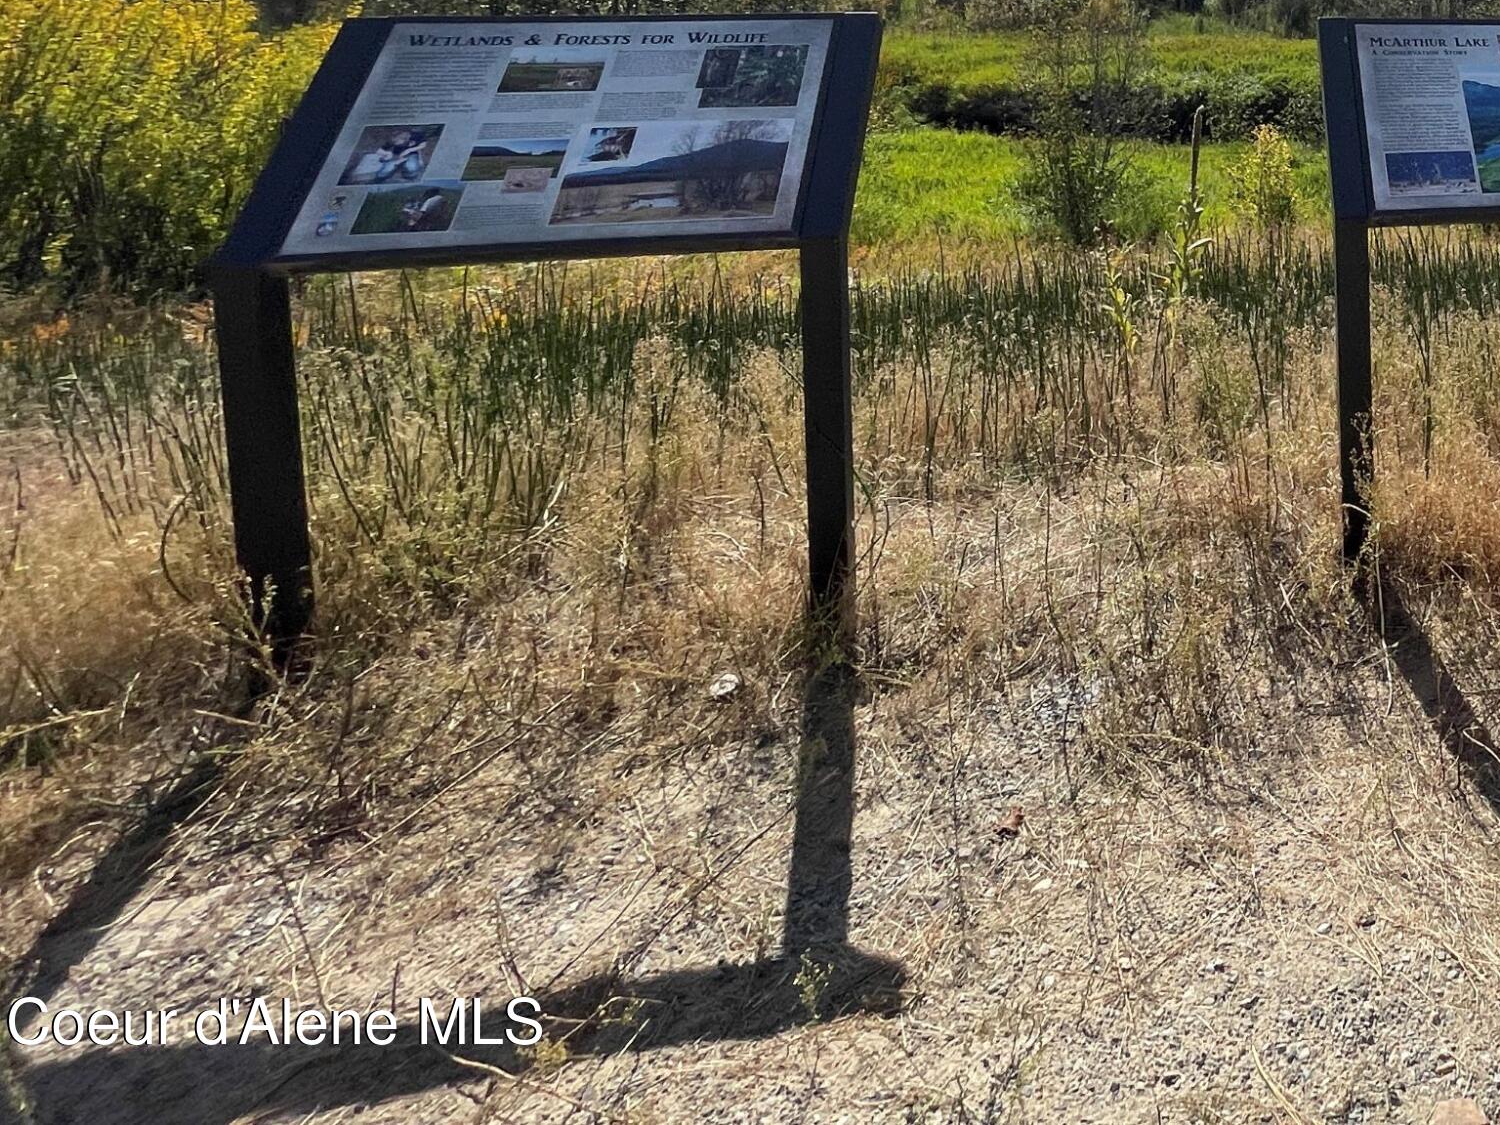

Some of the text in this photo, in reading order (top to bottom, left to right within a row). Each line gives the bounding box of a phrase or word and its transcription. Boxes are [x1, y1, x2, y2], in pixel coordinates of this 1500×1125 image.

[409, 31, 769, 47] WETLANDS & FORESTS FOR WILDLIFE
[1454, 36, 1490, 48] LAKE
